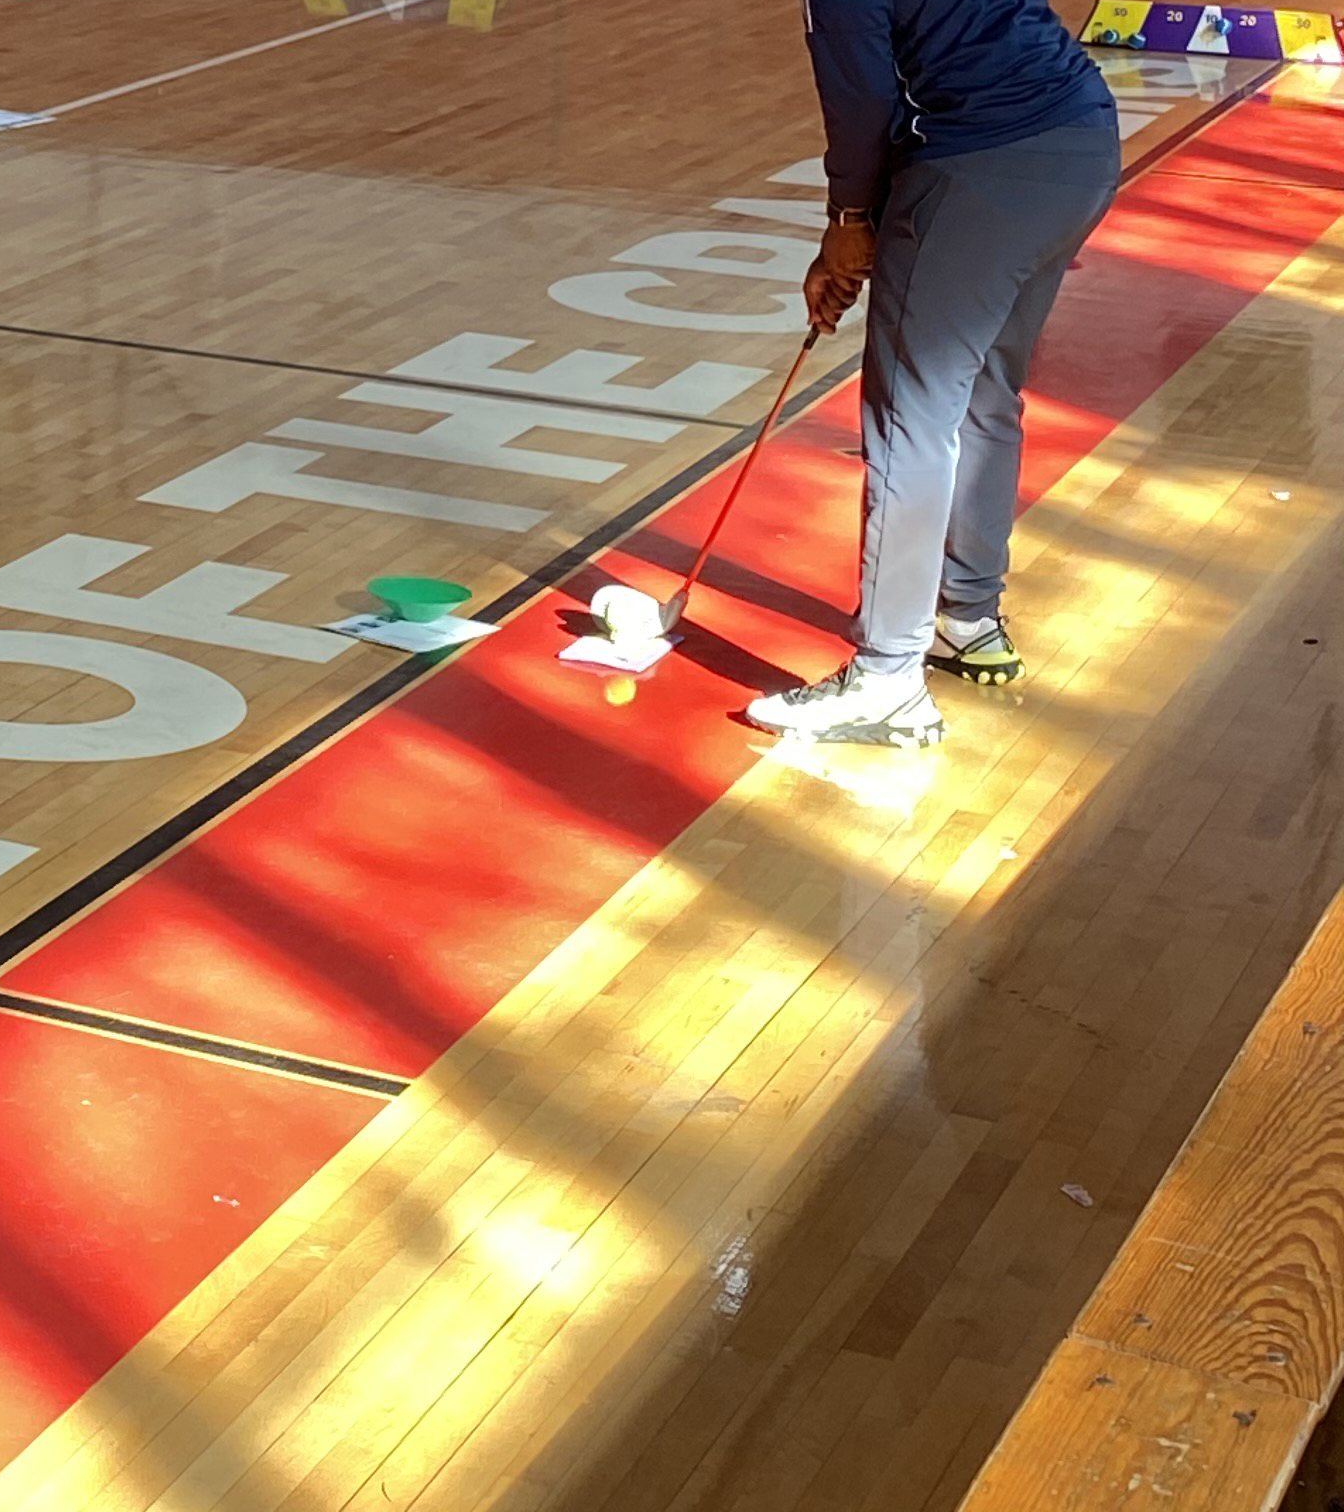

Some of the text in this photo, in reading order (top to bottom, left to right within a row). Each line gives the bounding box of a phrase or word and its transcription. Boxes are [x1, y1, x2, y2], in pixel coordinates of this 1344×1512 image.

[1166, 10, 1184, 22] 20
[1239, 14, 1257, 26] 20
[136, 330, 772, 532] THE
